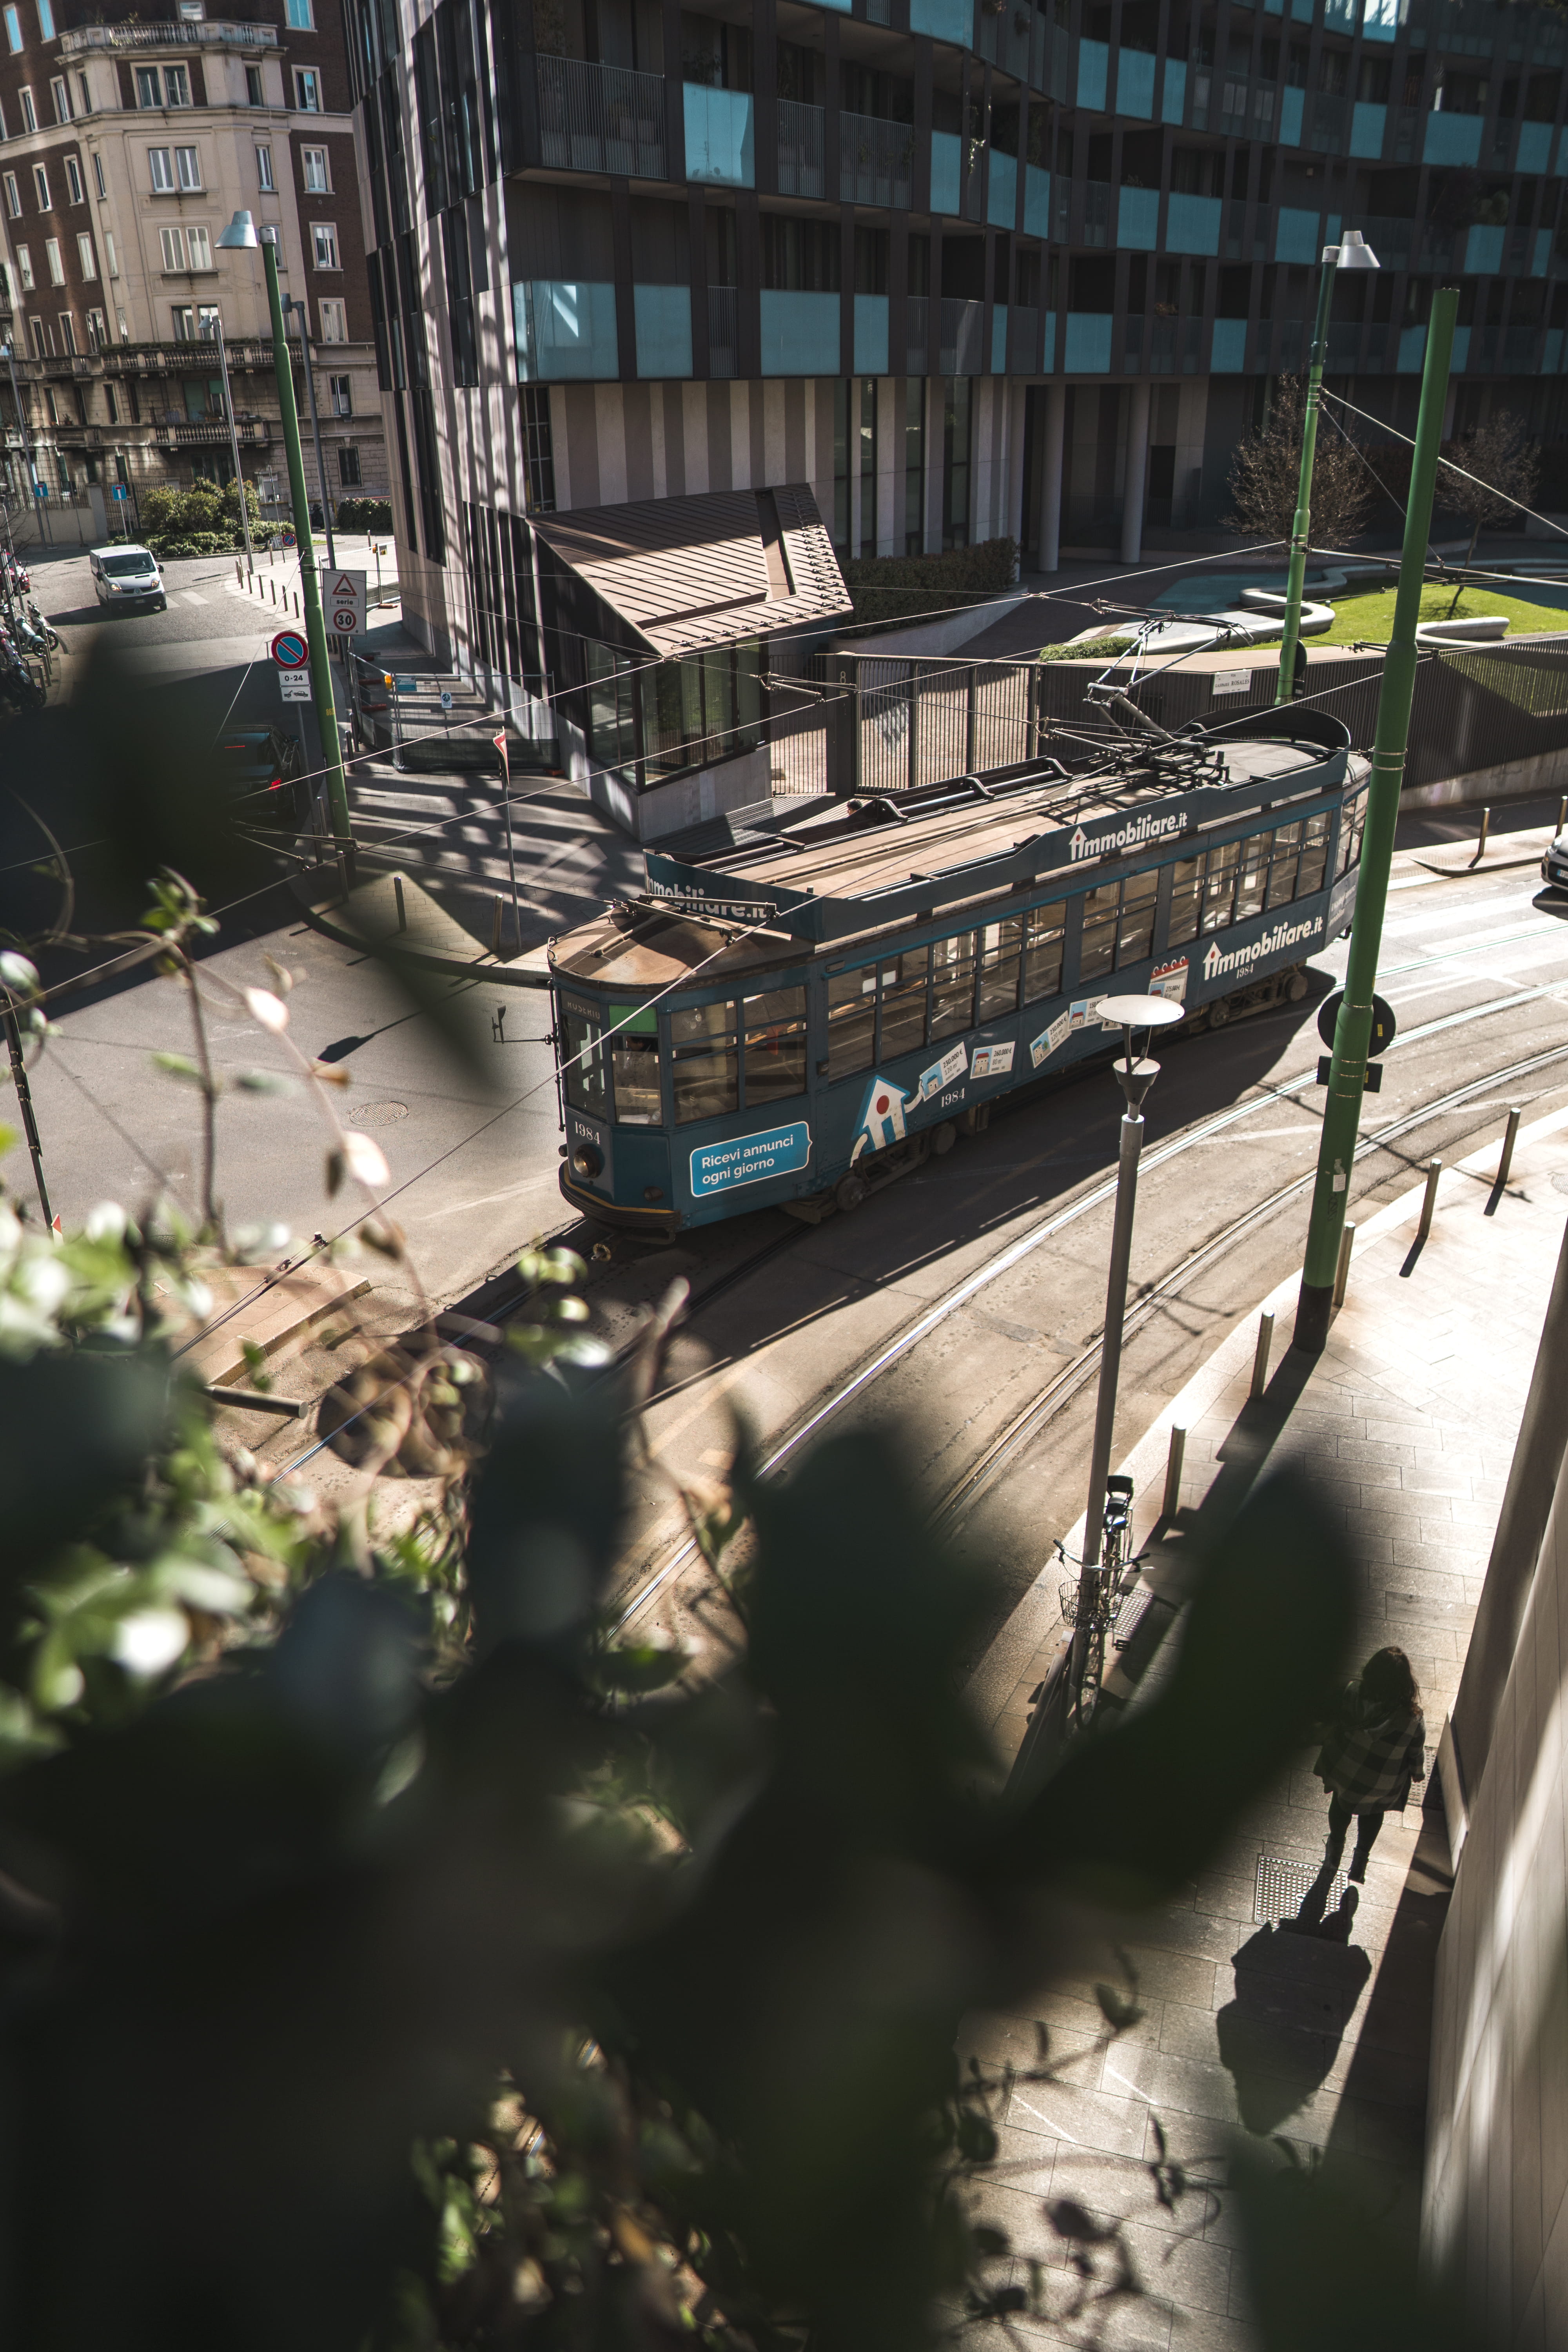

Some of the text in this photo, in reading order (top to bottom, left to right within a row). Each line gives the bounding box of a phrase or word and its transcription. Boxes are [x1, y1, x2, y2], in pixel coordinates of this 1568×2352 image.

[338, 614, 352, 625] 30
[840, 671, 846, 684] 8
[1236, 963, 1254, 979] 1984
[943, 1051, 959, 1068] 230.000
[994, 1048, 1009, 1057] 260.000
[942, 1087, 965, 1107] 1984
[575, 1121, 600, 1145] 1984
[702, 1134, 793, 1169] Ricevi annunci
[702, 1158, 775, 1185] ogni giorno
